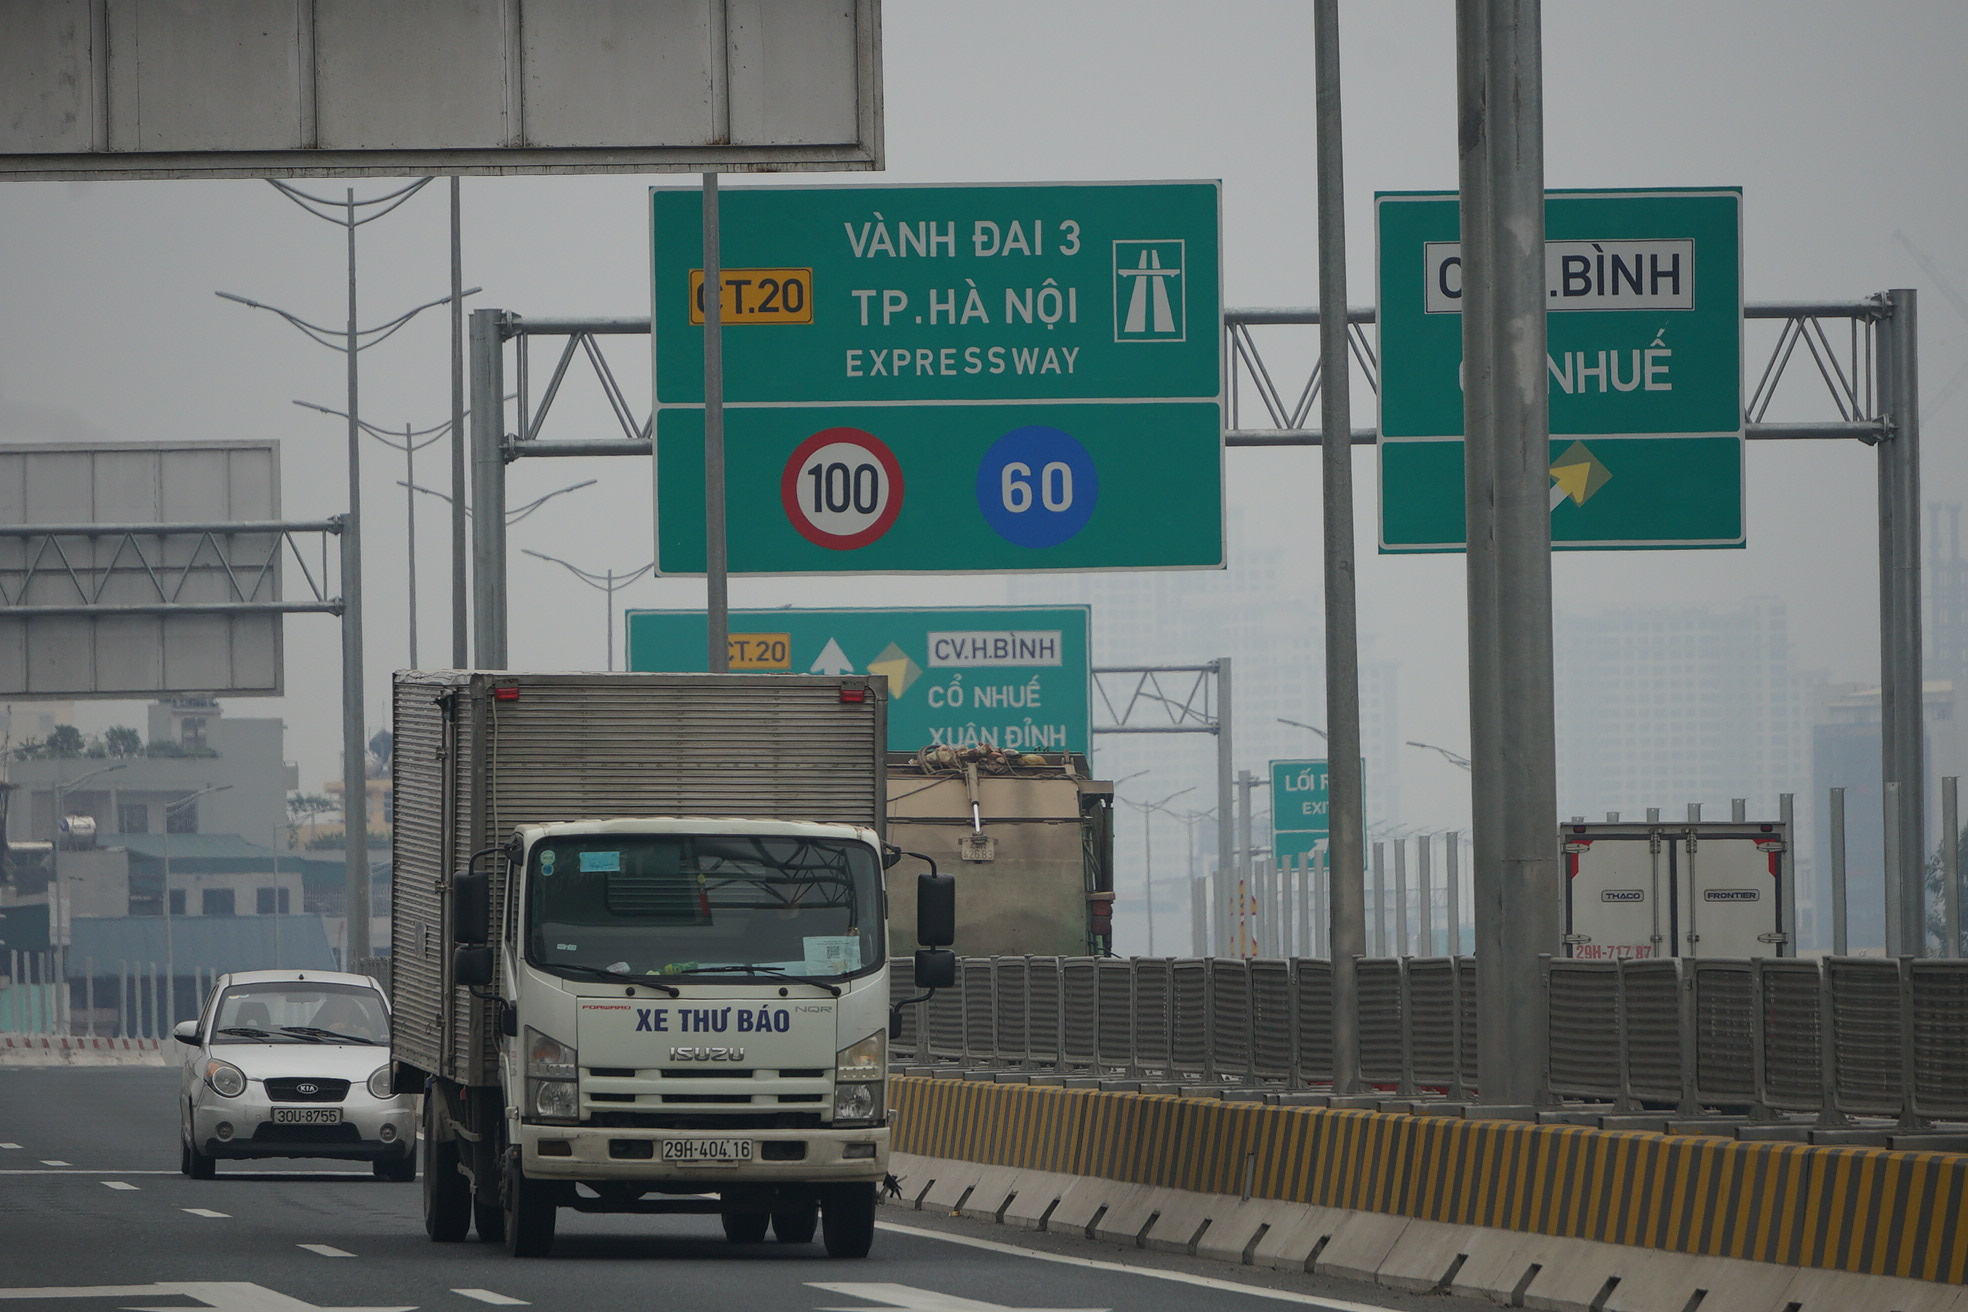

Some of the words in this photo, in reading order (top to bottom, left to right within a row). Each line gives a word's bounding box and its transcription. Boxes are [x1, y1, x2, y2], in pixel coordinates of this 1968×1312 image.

[844, 212, 955, 258] VÀNH
[972, 220, 1043, 257] ĐAI
[1059, 220, 1081, 256] 3
[852, 278, 990, 326] TP.HÀ
[1005, 278, 1077, 331] NỘI
[846, 346, 1080, 377] EXPRESSWAY
[807, 462, 879, 515] 100
[1001, 461, 1073, 513] 60
[728, 641, 785, 662] T.20
[935, 632, 1055, 660] CV.H.BÌNH
[928, 673, 964, 708] CỔ
[974, 674, 1041, 708] NHUẾ
[929, 721, 998, 749] XUÂN
[1005, 717, 1066, 748] ĐỈNH
[1285, 767, 1314, 791] LỐI
[1302, 801, 1329, 815] EXI
[1605, 892, 1641, 900] THACO
[1707, 891, 1757, 899] FRONTIER
[1576, 945, 1652, 959] 29H-71787
[635, 1008, 668, 1031] XE
[678, 1006, 731, 1032] THƯ
[737, 1004, 790, 1032] BÁO
[669, 1047, 744, 1062] ISUZU
[278, 1110, 337, 1123] 30U-8755
[664, 1141, 750, 1158] 29H-404.16
